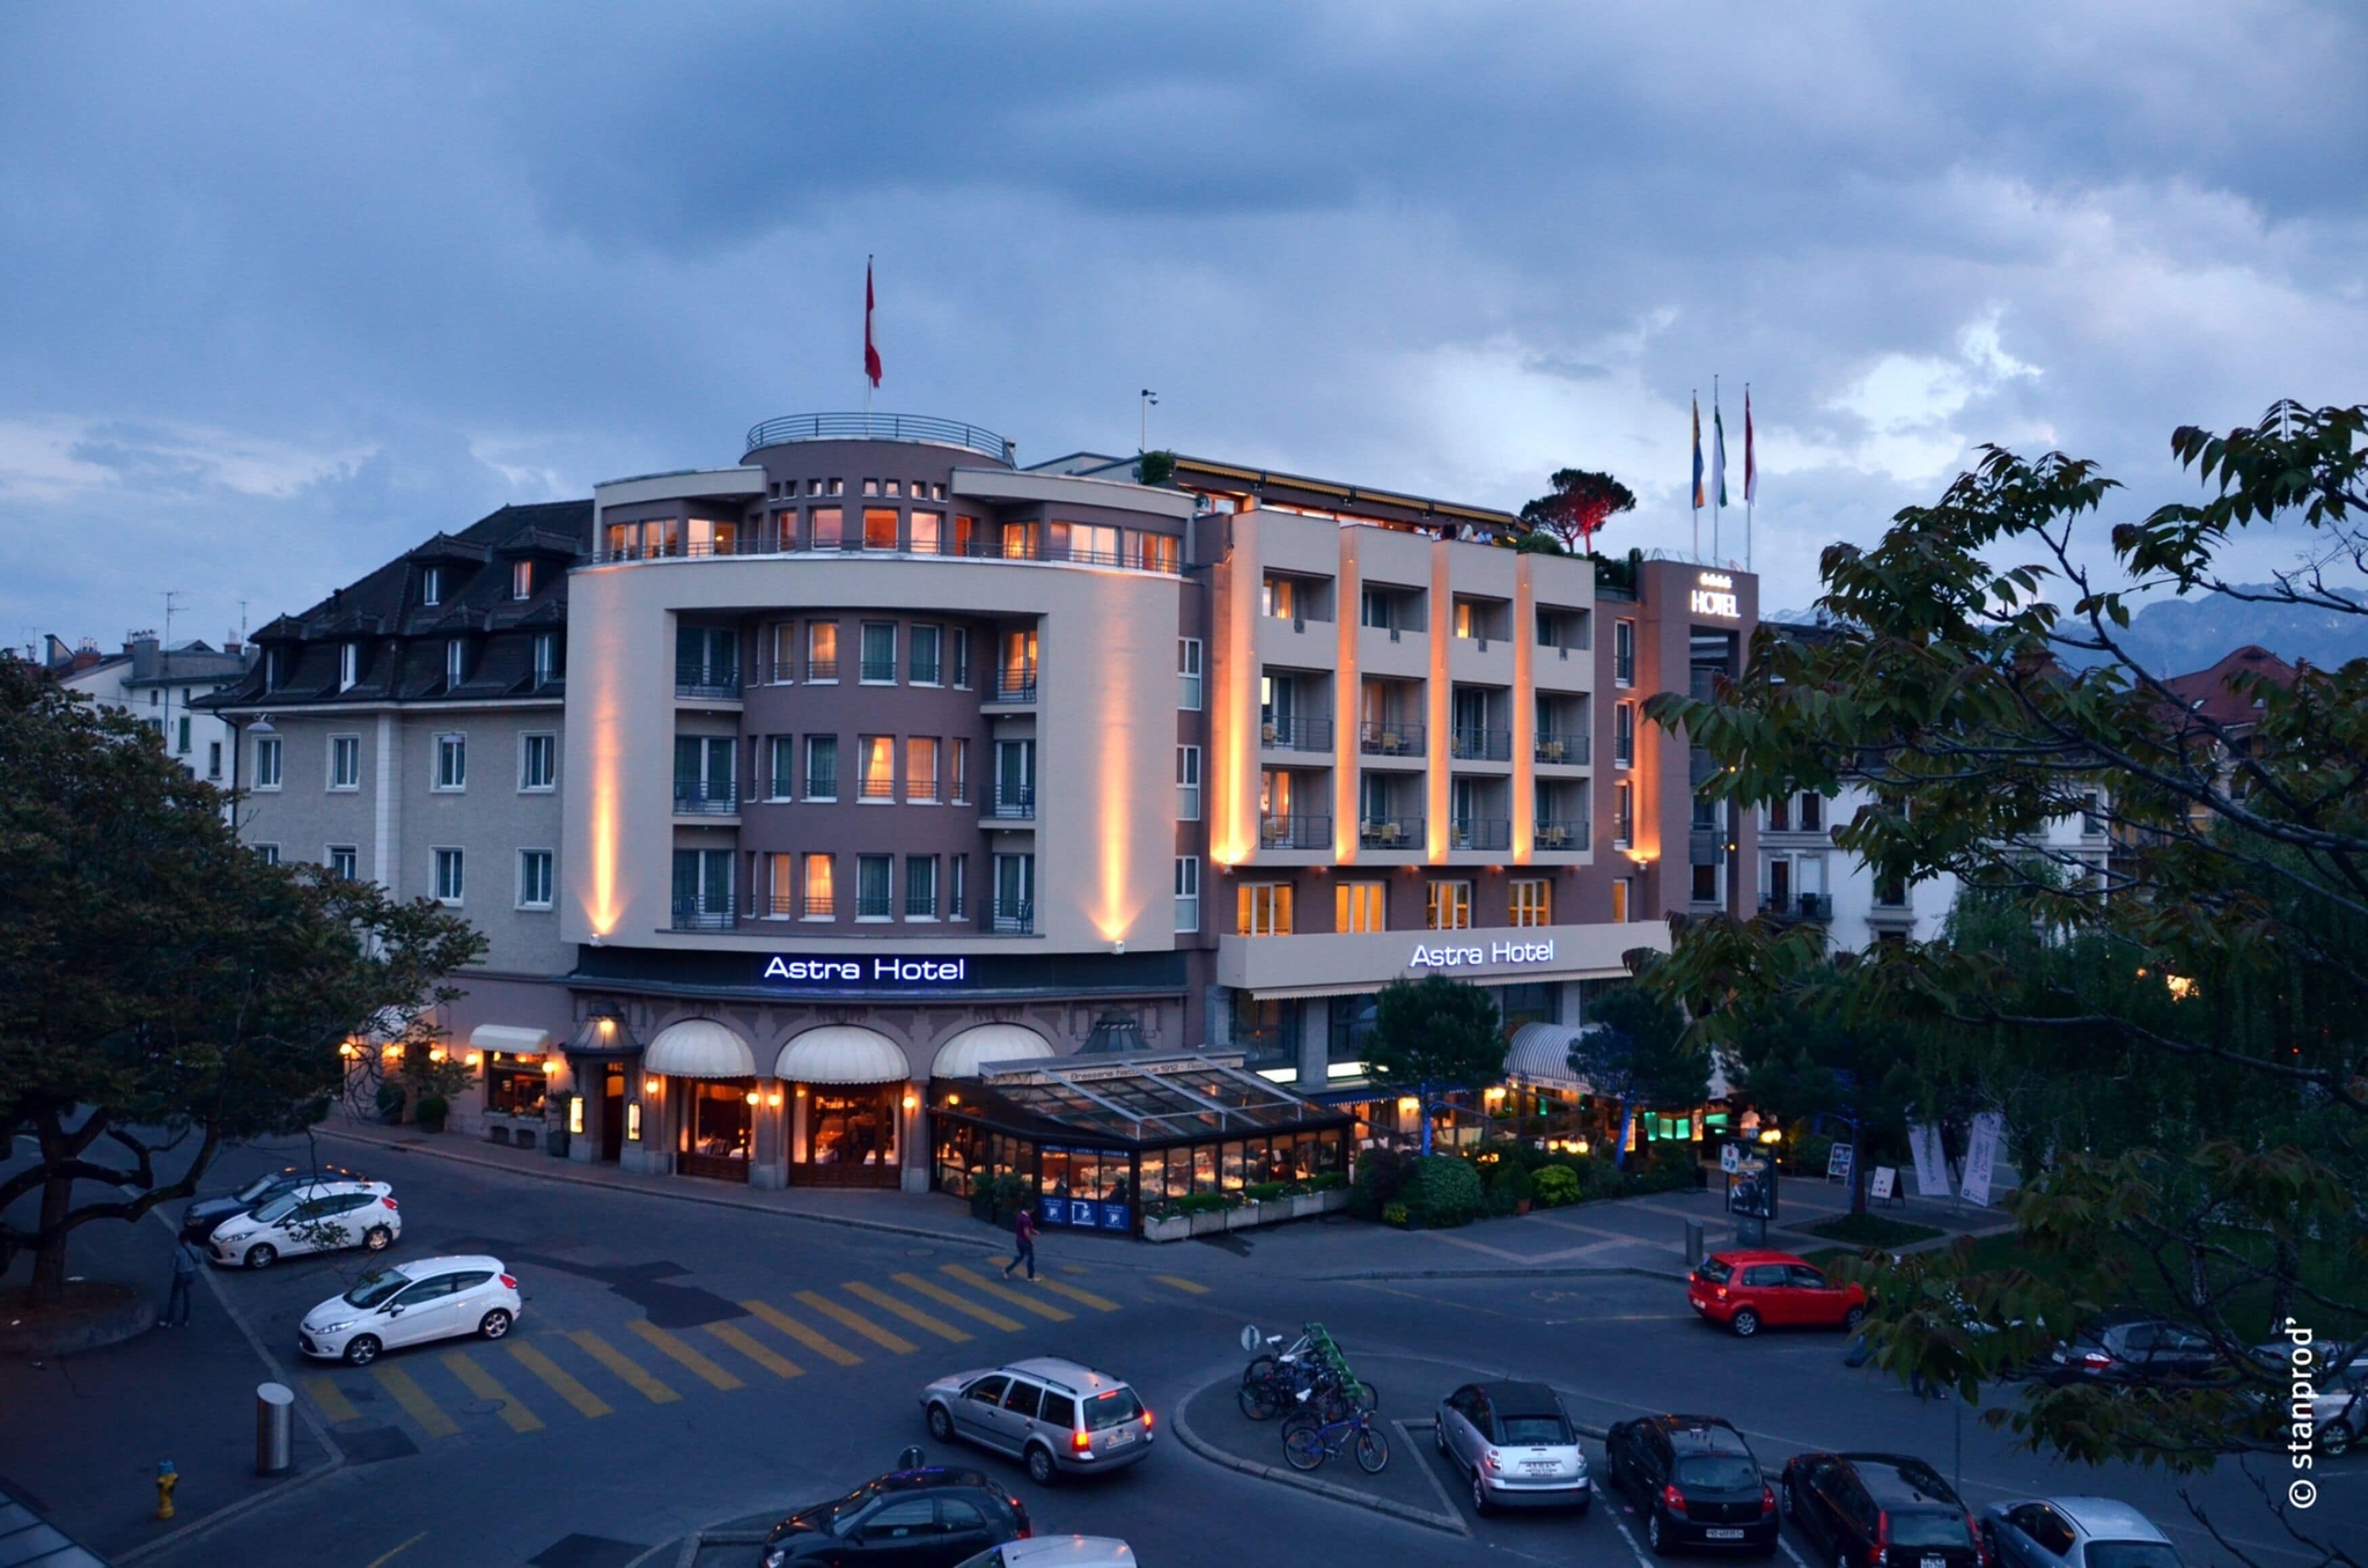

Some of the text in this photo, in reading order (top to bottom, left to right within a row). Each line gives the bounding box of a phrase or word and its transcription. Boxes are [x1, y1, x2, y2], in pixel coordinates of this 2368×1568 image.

[1691, 590, 1741, 618] HOTEL
[1409, 939, 1553, 967] Astra Hotel
[764, 956, 964, 980] Astra Hotel
[1161, 1064, 1179, 1072] 1912
